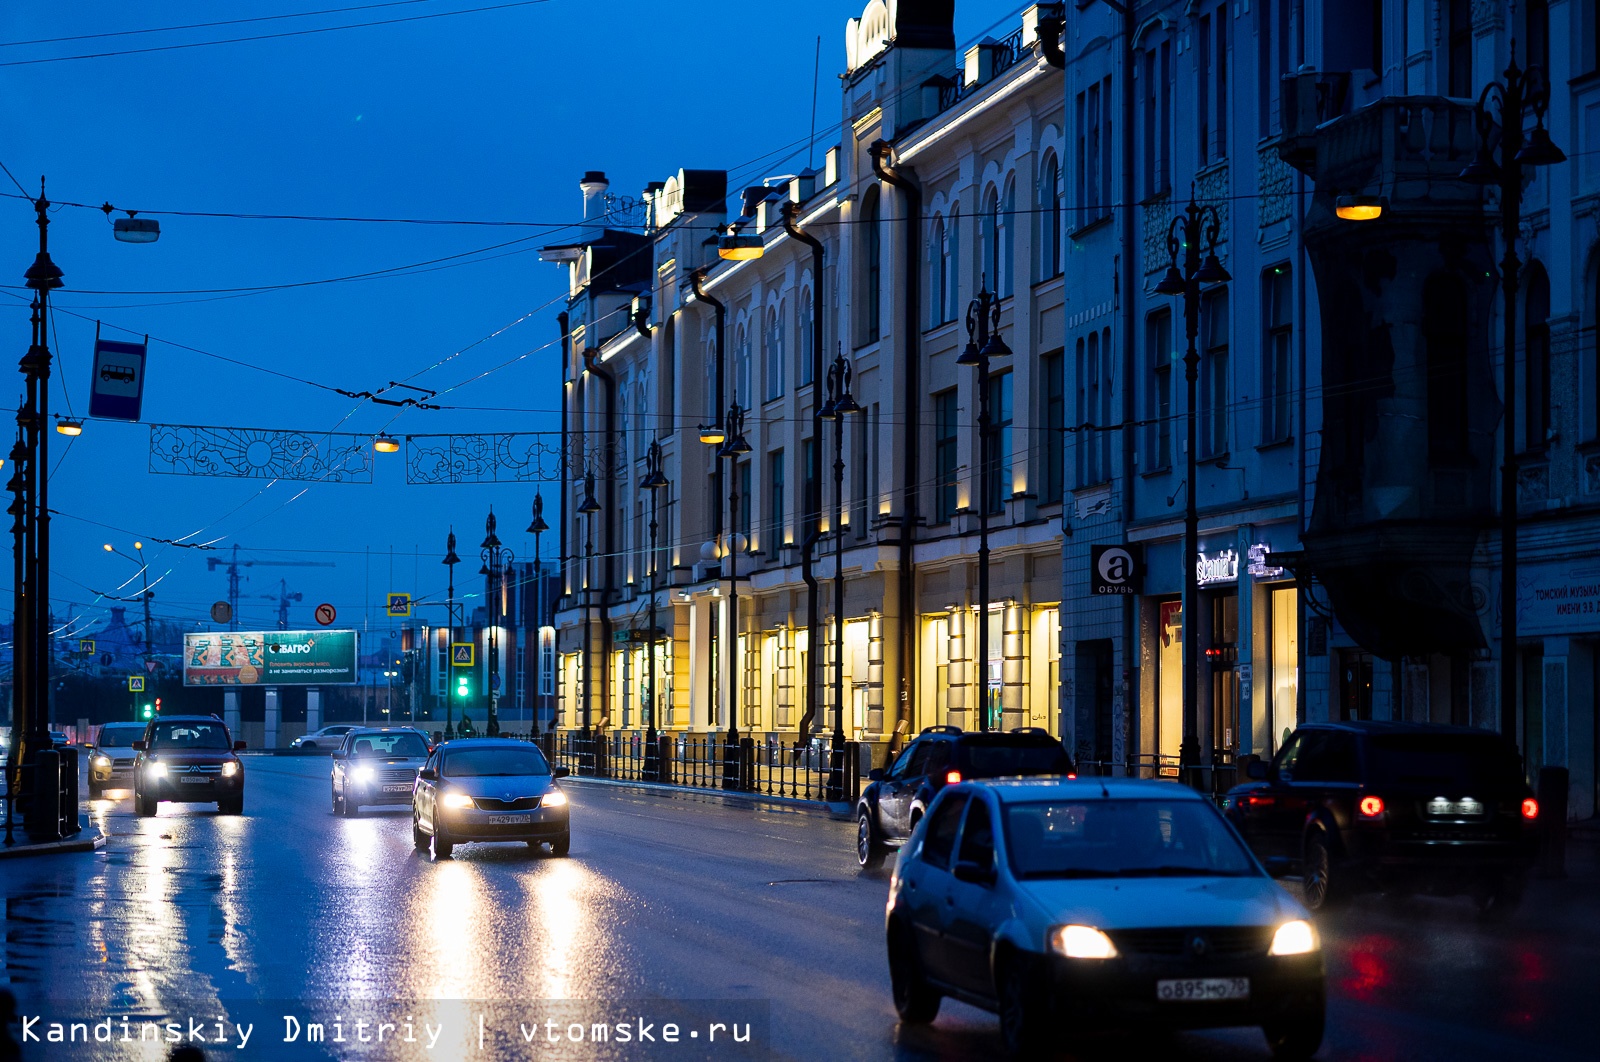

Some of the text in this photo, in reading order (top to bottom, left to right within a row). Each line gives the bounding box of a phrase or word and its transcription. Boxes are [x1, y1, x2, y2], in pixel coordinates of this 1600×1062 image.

[1098, 585, 1134, 594] ОБУВЬ
[1536, 585, 1567, 600] ТОМСКИЙ
[1557, 603, 1580, 615] ИМЕНИ
